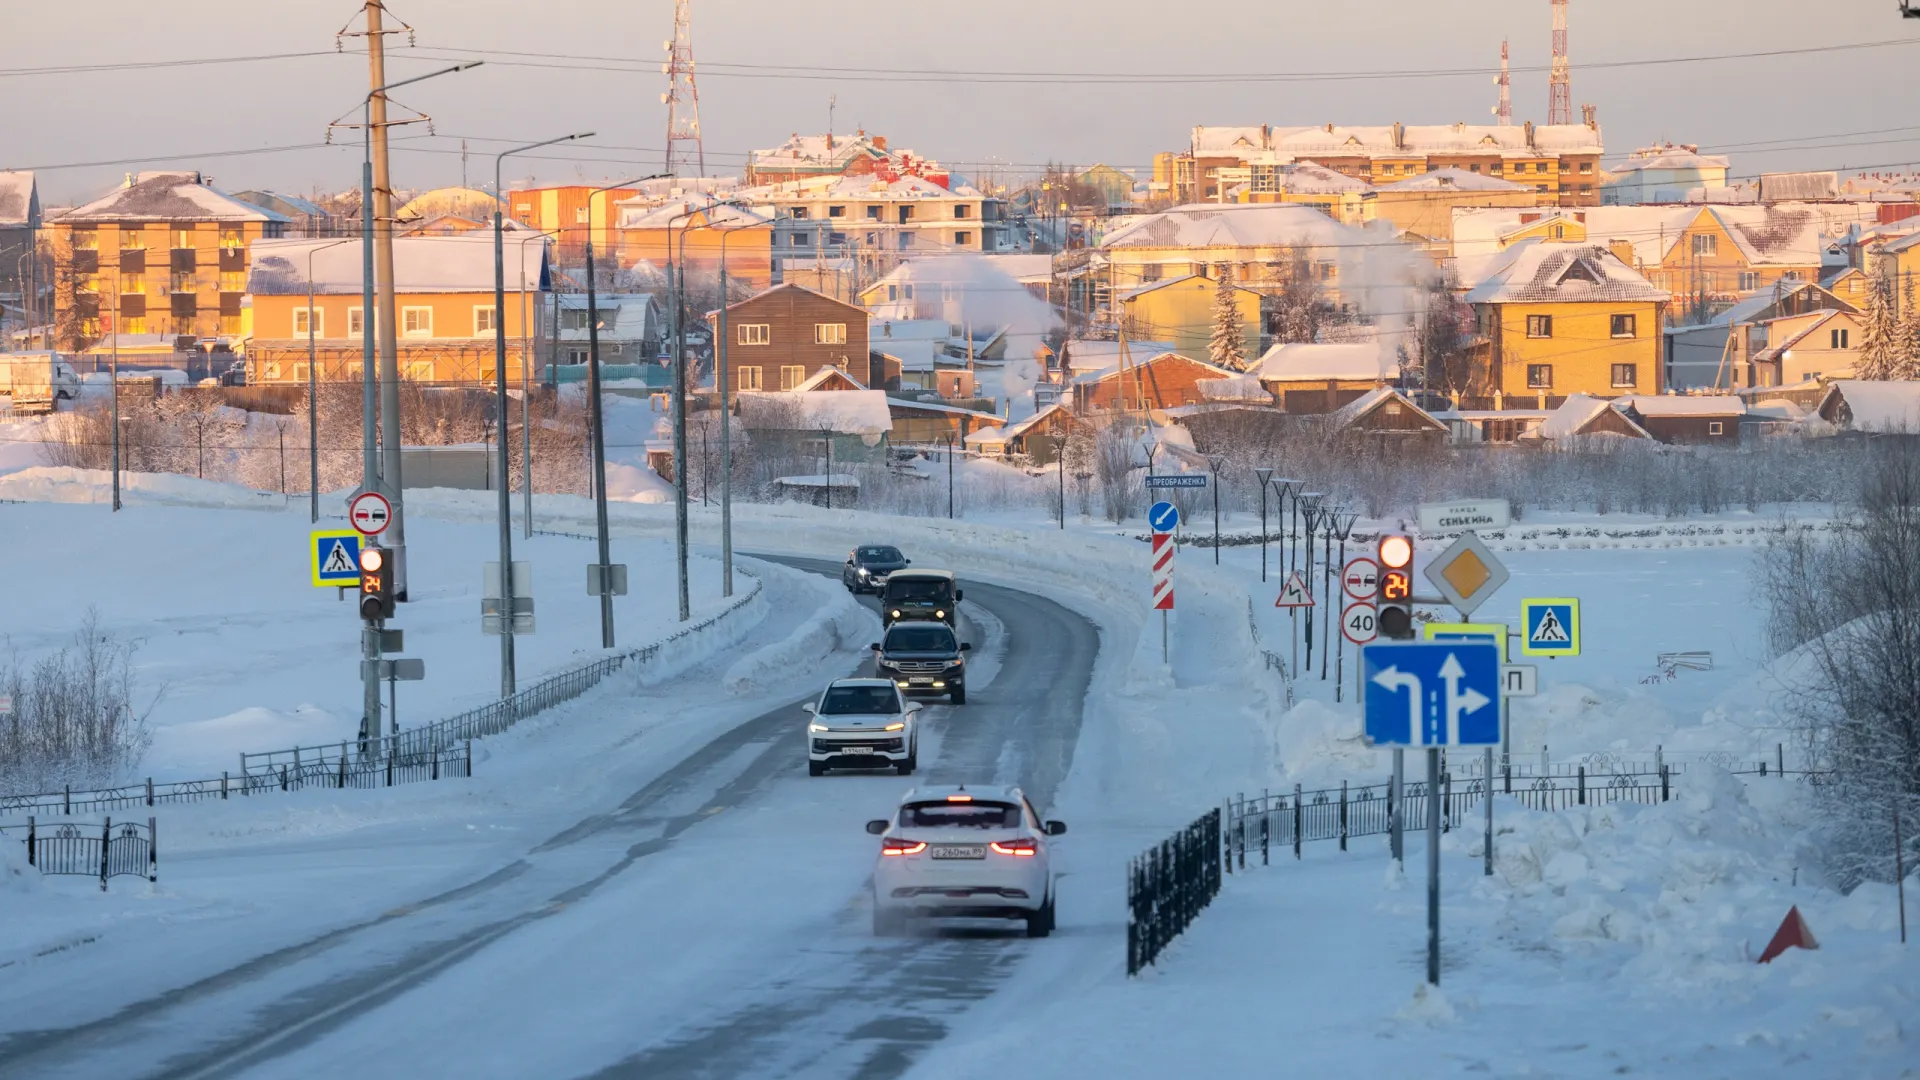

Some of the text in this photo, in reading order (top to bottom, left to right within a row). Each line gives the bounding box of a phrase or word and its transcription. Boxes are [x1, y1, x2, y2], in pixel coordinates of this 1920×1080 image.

[1439, 515, 1494, 527] СЕНЬКИНА
[364, 575, 381, 593] 24
[1385, 573, 1409, 599] 24
[1350, 615, 1374, 632] 40
